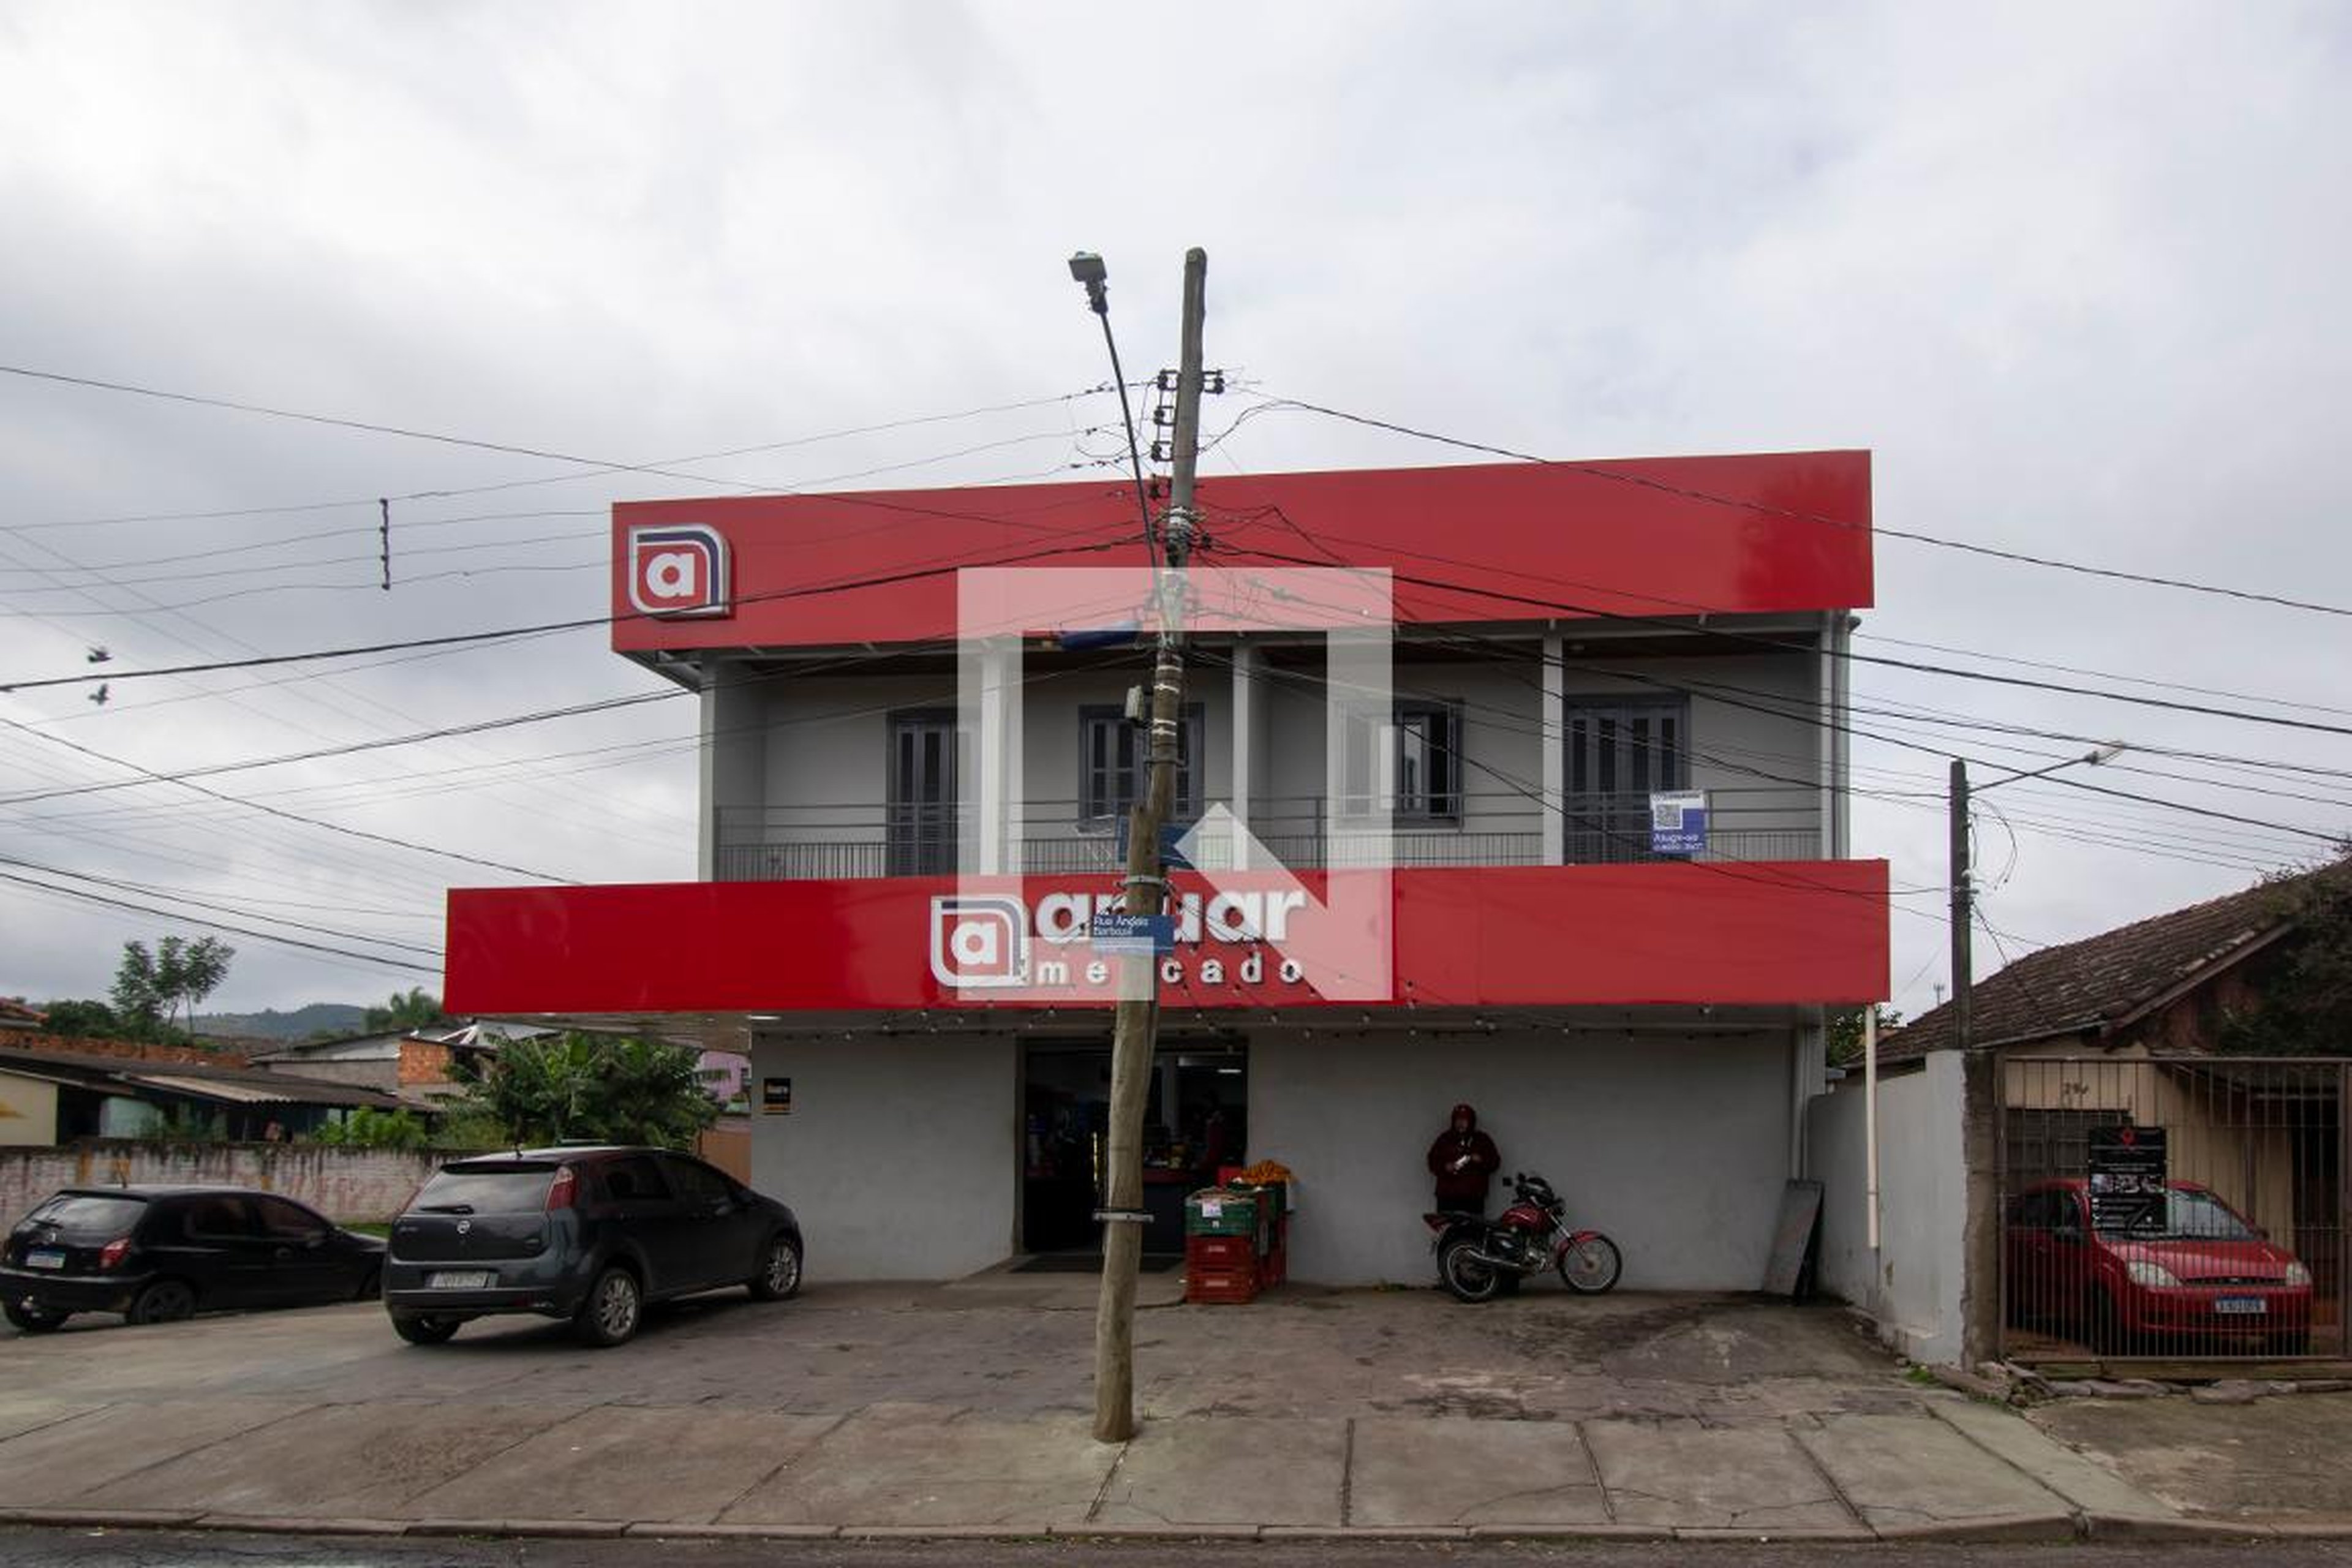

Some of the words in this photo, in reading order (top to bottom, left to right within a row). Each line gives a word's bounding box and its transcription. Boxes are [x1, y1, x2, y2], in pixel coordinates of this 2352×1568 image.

[646, 553, 695, 598] a
[951, 922, 997, 965] a
[1036, 951, 1303, 984] mecado
